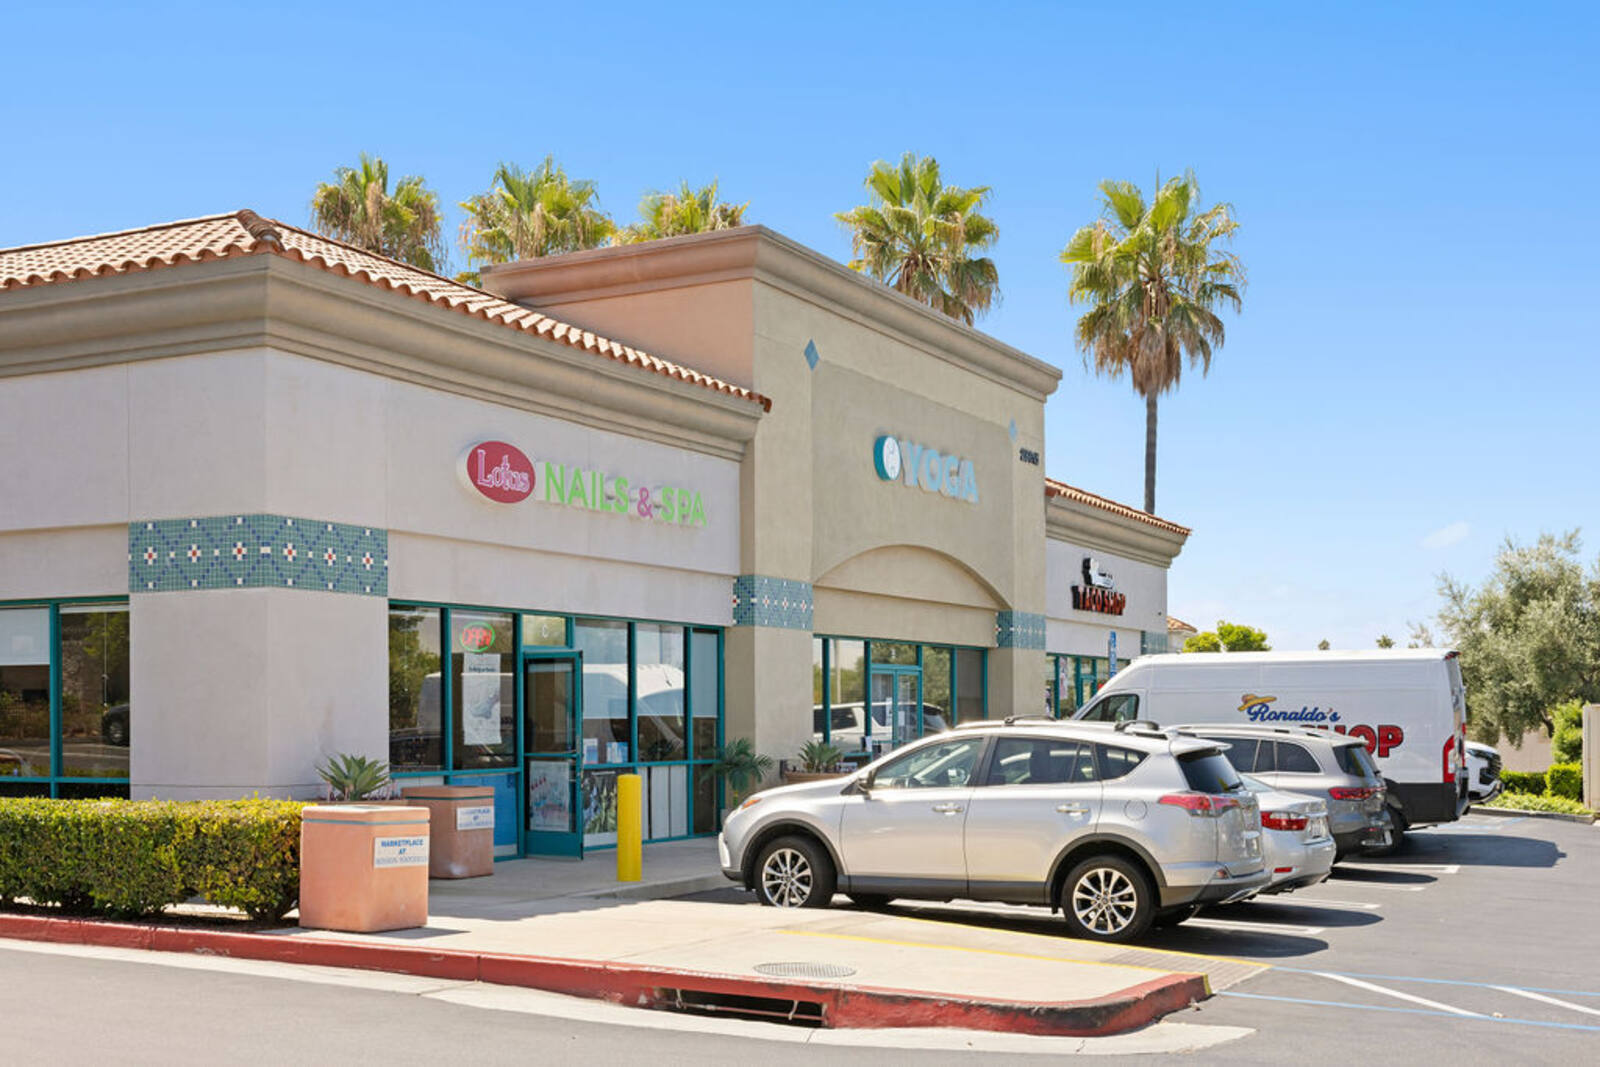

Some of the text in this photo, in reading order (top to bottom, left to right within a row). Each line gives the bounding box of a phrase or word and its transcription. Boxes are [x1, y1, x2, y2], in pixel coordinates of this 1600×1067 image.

[477, 449, 530, 492] Lotus
[900, 440, 980, 504] YOGA
[544, 462, 708, 527] NAILS & SPA
[1073, 586, 1126, 615] TACO SHOP
[462, 626, 493, 647] OPEN
[1246, 702, 1341, 722] Ronaldo's
[1301, 724, 1404, 758] OP
